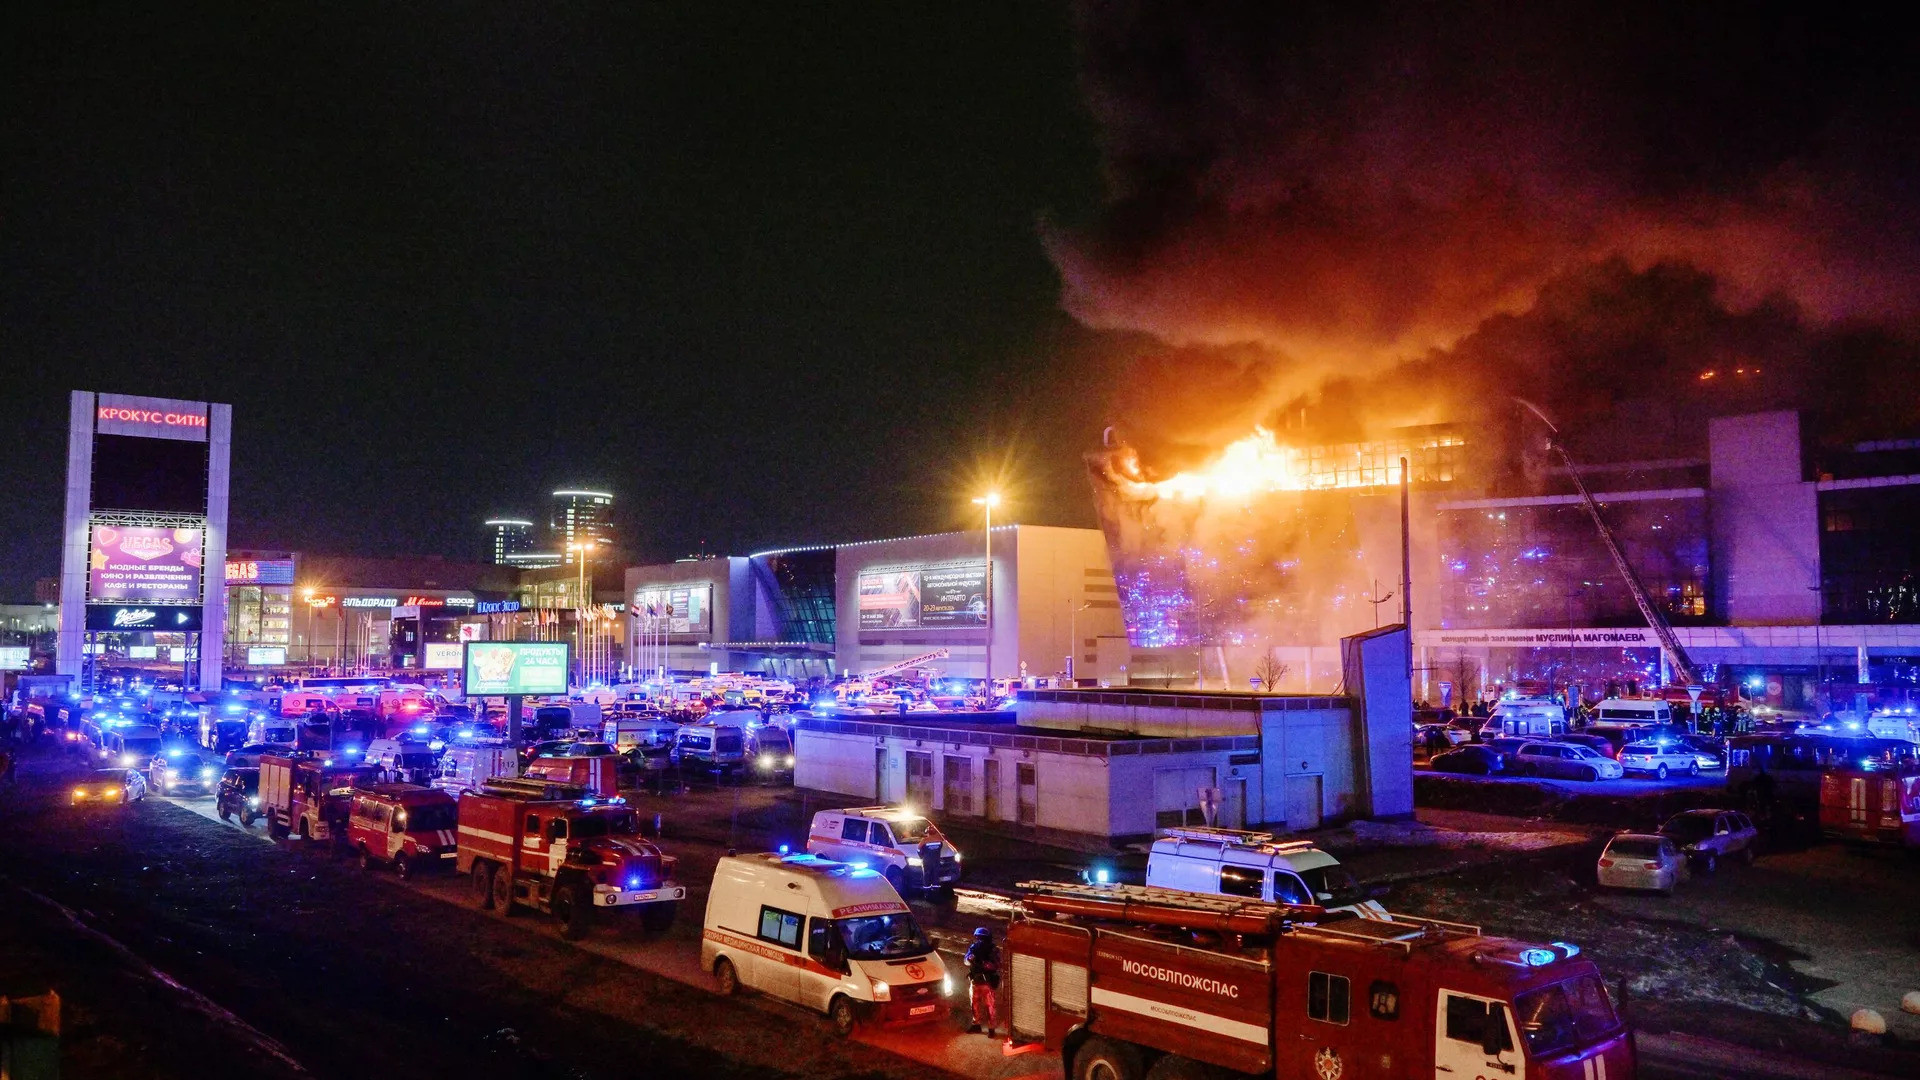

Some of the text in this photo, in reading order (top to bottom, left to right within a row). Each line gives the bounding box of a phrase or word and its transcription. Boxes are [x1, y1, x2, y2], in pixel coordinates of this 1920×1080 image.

[100, 407, 206, 427] КРОКУС СИТИ
[122, 536, 171, 550] VEGAS
[109, 564, 185, 573] МОДНЫЕ БРЕНДЫ
[136, 582, 189, 590] РЕСТОРАНЫ
[342, 597, 398, 607] ЭЛЬДОРАДО
[1535, 633, 1582, 643] МУСЛИМА
[1583, 633, 1646, 642] МАГОМАЕВА
[519, 647, 564, 656] ПРОДУКТЫ
[524, 657, 559, 665] 24 ЧАСА
[501, 760, 515, 769] 112
[840, 902, 902, 915] РЕАНИМАЦИЯ
[704, 930, 723, 941] СКОРАЯ
[723, 935, 761, 953] МЕДИЦИНСКАЯ
[1122, 959, 1239, 998] МОСОБЛПОЖСПАС
